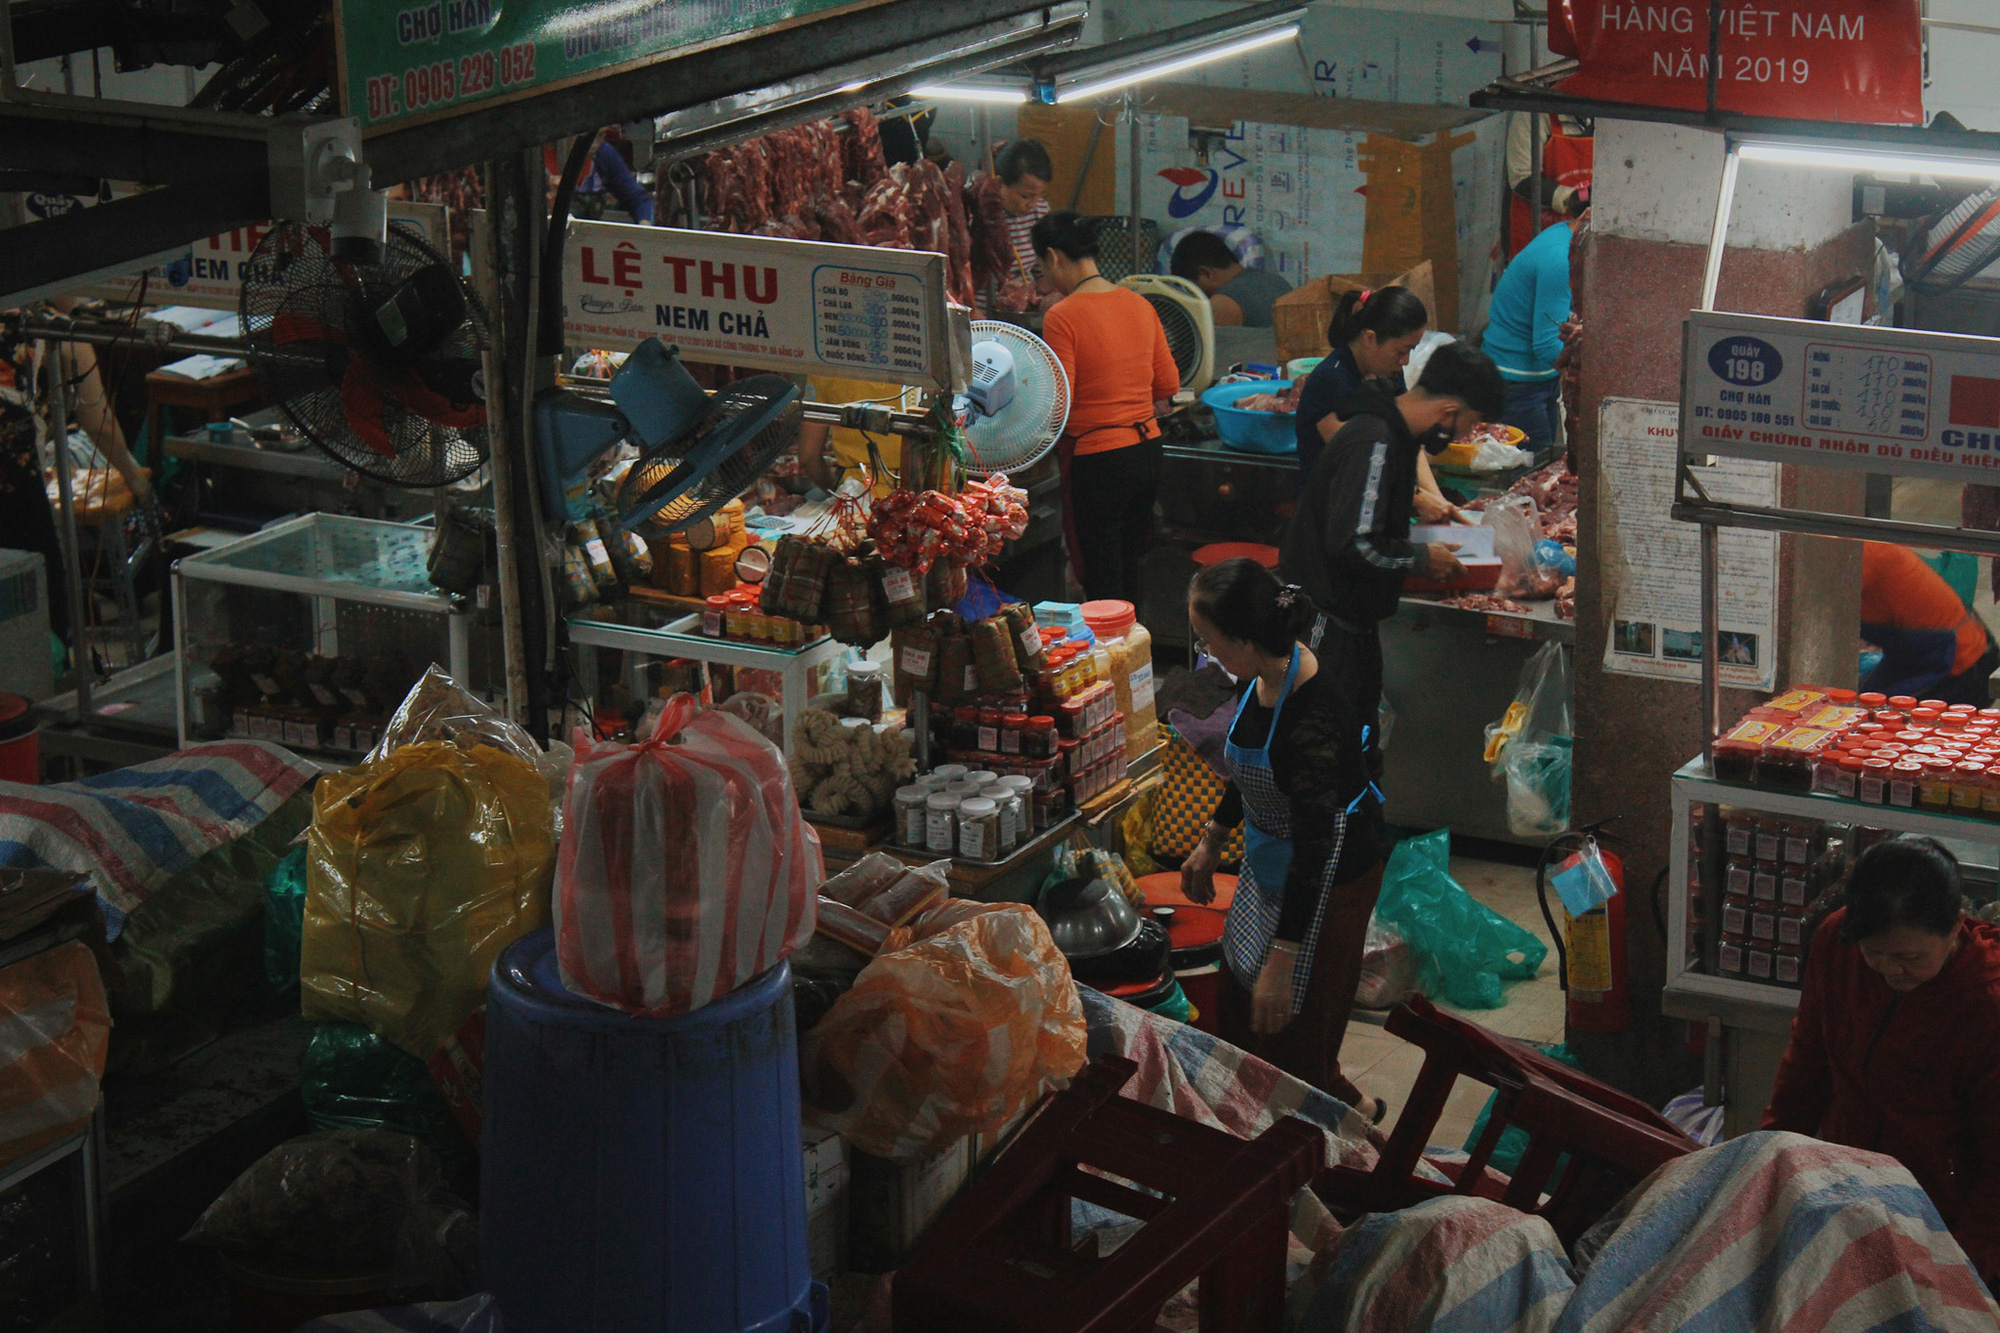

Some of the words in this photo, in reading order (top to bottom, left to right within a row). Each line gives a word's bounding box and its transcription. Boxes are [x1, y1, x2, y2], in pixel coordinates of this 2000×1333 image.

[399, 2, 441, 43] CHỢ
[1601, 0, 1693, 33] HÀNG
[1791, 13, 1864, 40] NAM
[368, 75, 399, 119] ĐT:
[405, 59, 454, 109] 0905
[460, 51, 494, 95] 229
[501, 42, 535, 85] 052
[1653, 47, 1723, 79] NĂM
[1736, 56, 1809, 84] 2019
[581, 242, 643, 296] LỆ
[664, 256, 777, 304] THU
[841, 272, 872, 288] Bảng
[876, 276, 896, 289] Giá
[656, 304, 708, 331] NEM
[719, 310, 770, 338] CHẢ
[1726, 358, 1765, 381] 198
[1720, 390, 1744, 403] CHỢ
[1717, 408, 1747, 421] 0905
[1775, 414, 1795, 426] 551
[1702, 424, 1744, 440] GIẤY
[1750, 431, 1812, 448] CHỨNG
[1819, 439, 1869, 456] NHẬN
[1910, 447, 1954, 463] ĐIỀU
